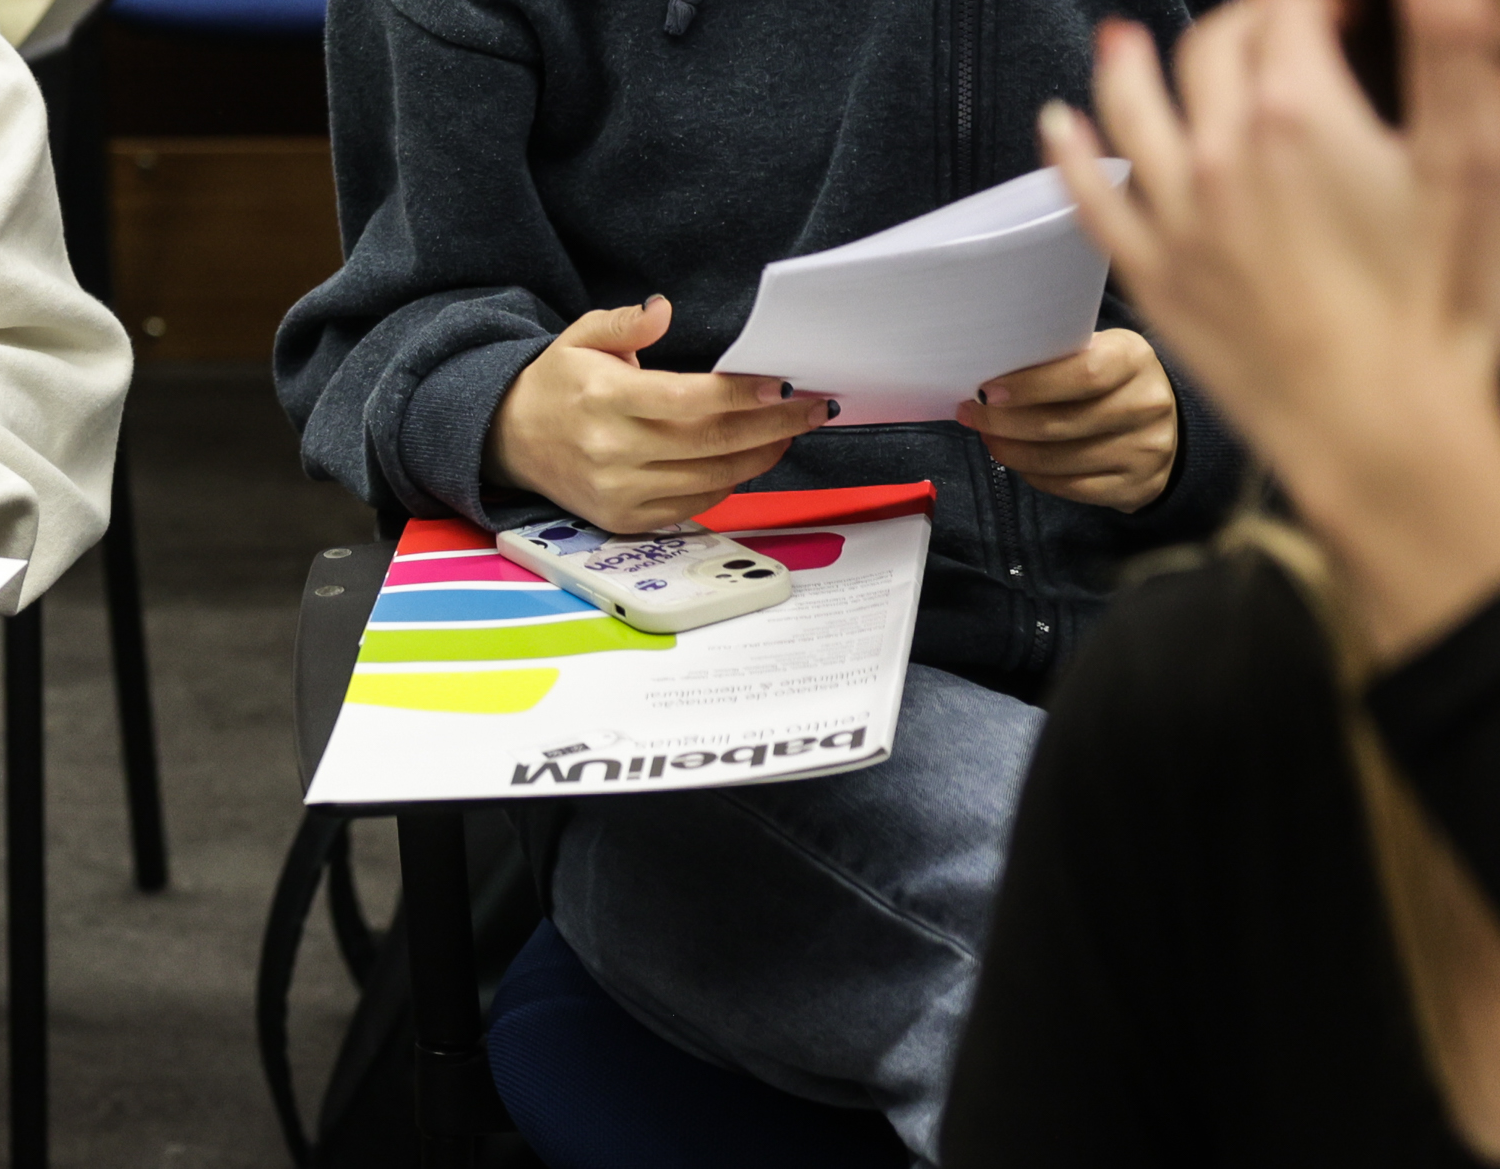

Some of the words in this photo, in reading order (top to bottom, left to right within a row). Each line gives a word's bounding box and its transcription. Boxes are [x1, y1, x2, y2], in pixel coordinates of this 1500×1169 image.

[745, 691, 768, 702] de
[795, 710, 871, 732] centro
[744, 727, 777, 740] de
